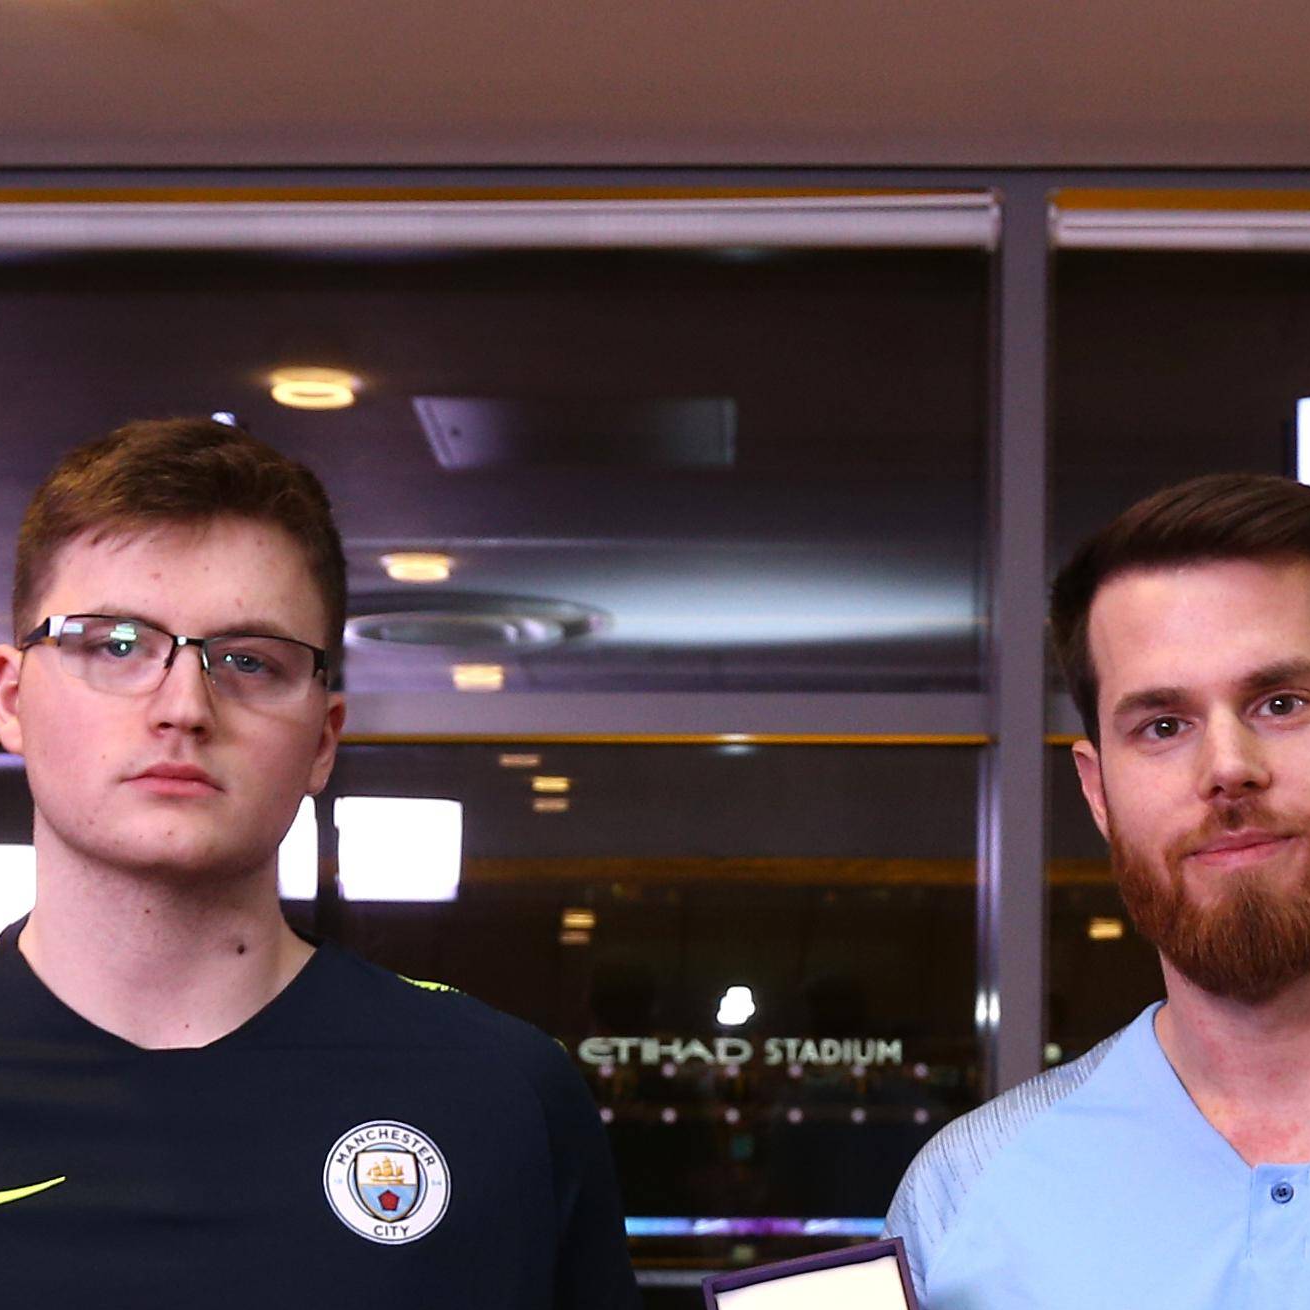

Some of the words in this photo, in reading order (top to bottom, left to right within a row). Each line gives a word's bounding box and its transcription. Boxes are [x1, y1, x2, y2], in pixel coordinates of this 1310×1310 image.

[577, 1036, 755, 1066] ETIHAD
[763, 1037, 903, 1065] STADIUM
[336, 1128, 437, 1167] MANCHESTER
[373, 1225, 411, 1237] CITY
